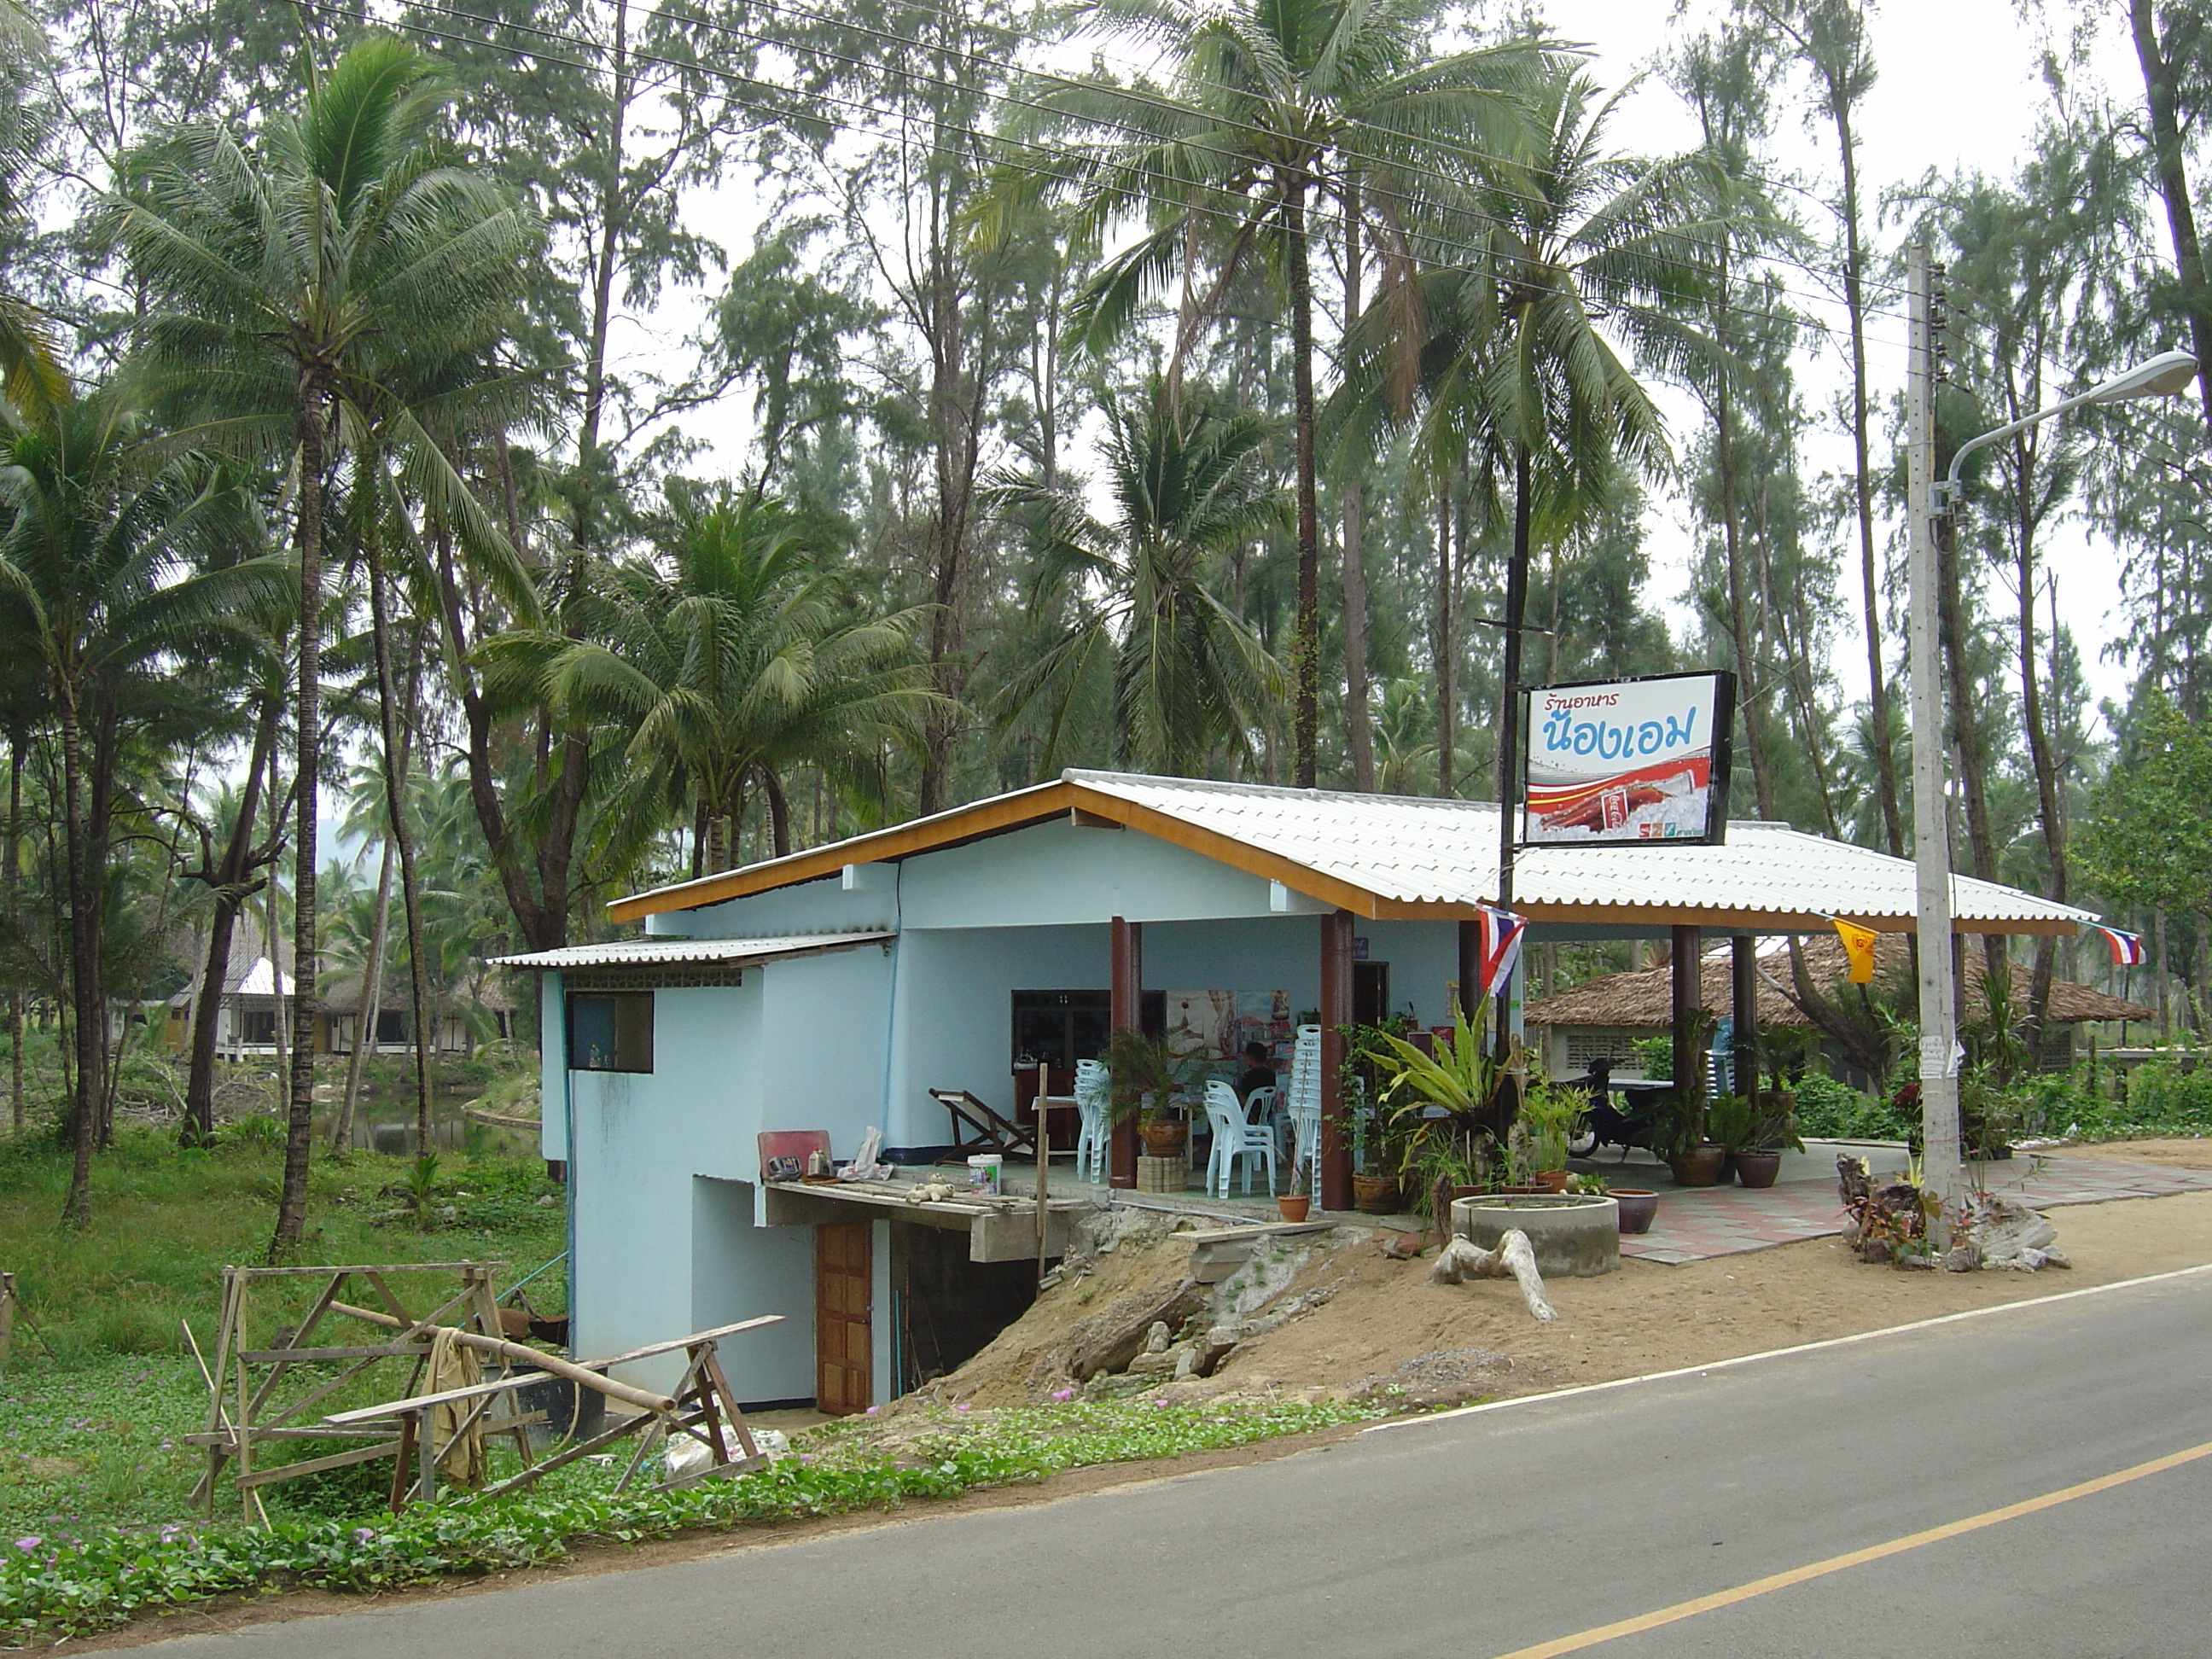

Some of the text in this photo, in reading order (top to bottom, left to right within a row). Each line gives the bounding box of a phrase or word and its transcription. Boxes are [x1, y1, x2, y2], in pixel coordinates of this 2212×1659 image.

[1545, 693, 1620, 711] ร้านอาหาร
[1543, 707, 1697, 760] น้องเอม
